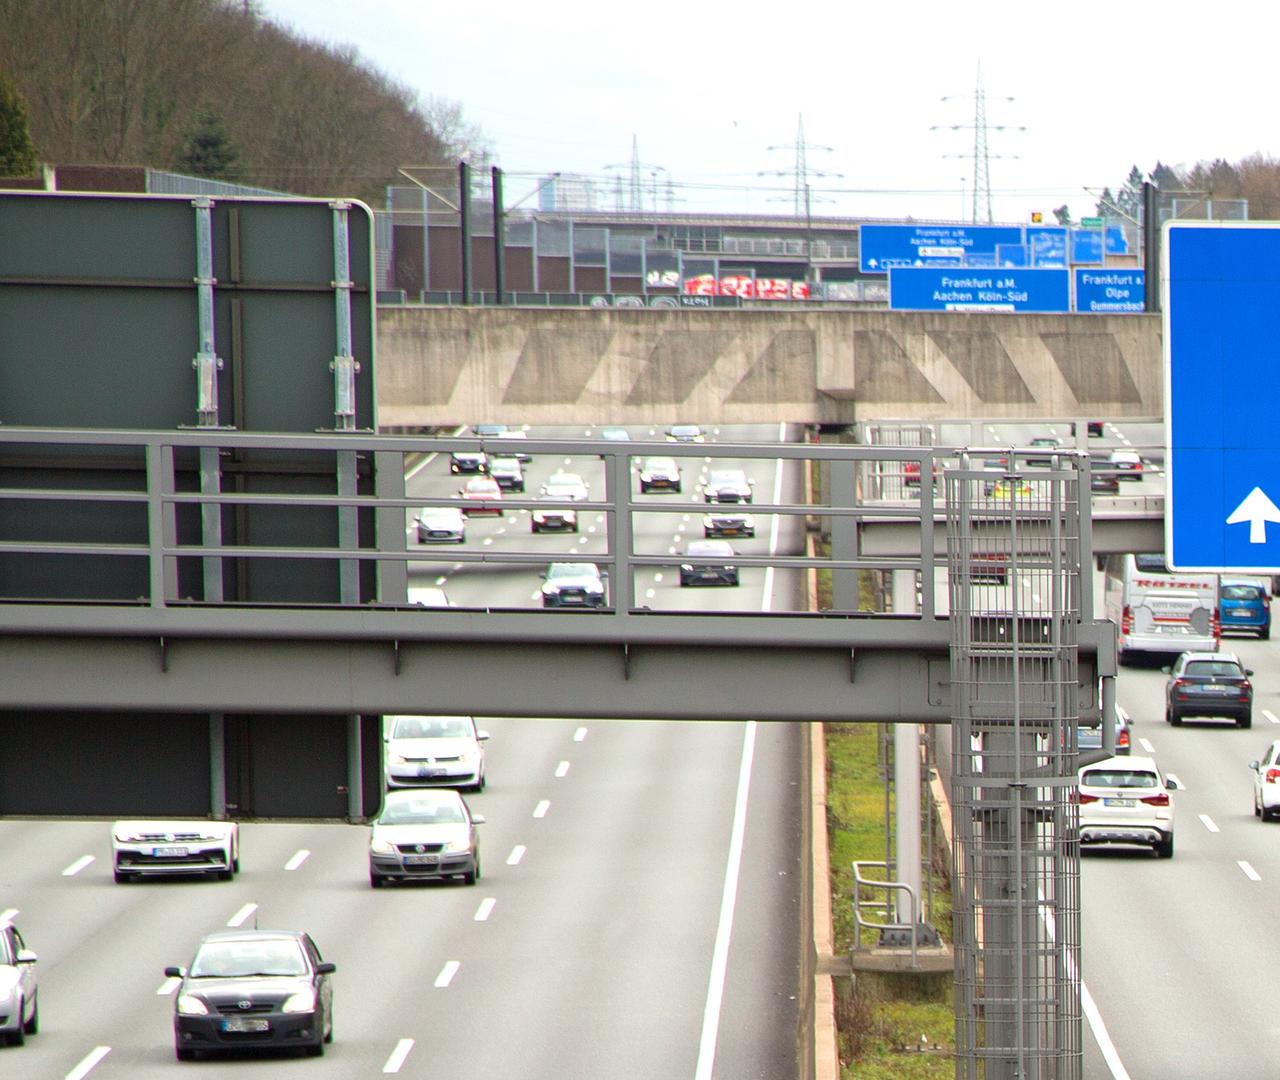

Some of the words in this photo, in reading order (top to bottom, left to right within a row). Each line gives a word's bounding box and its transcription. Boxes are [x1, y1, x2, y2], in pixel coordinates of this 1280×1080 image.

[941, 277, 992, 288] Frankfurt
[1082, 274, 1133, 285] Frankfurt
[933, 291, 973, 301] Aachen
[978, 290, 1028, 302] Köln-Süd
[1106, 288, 1130, 299] Olpe
